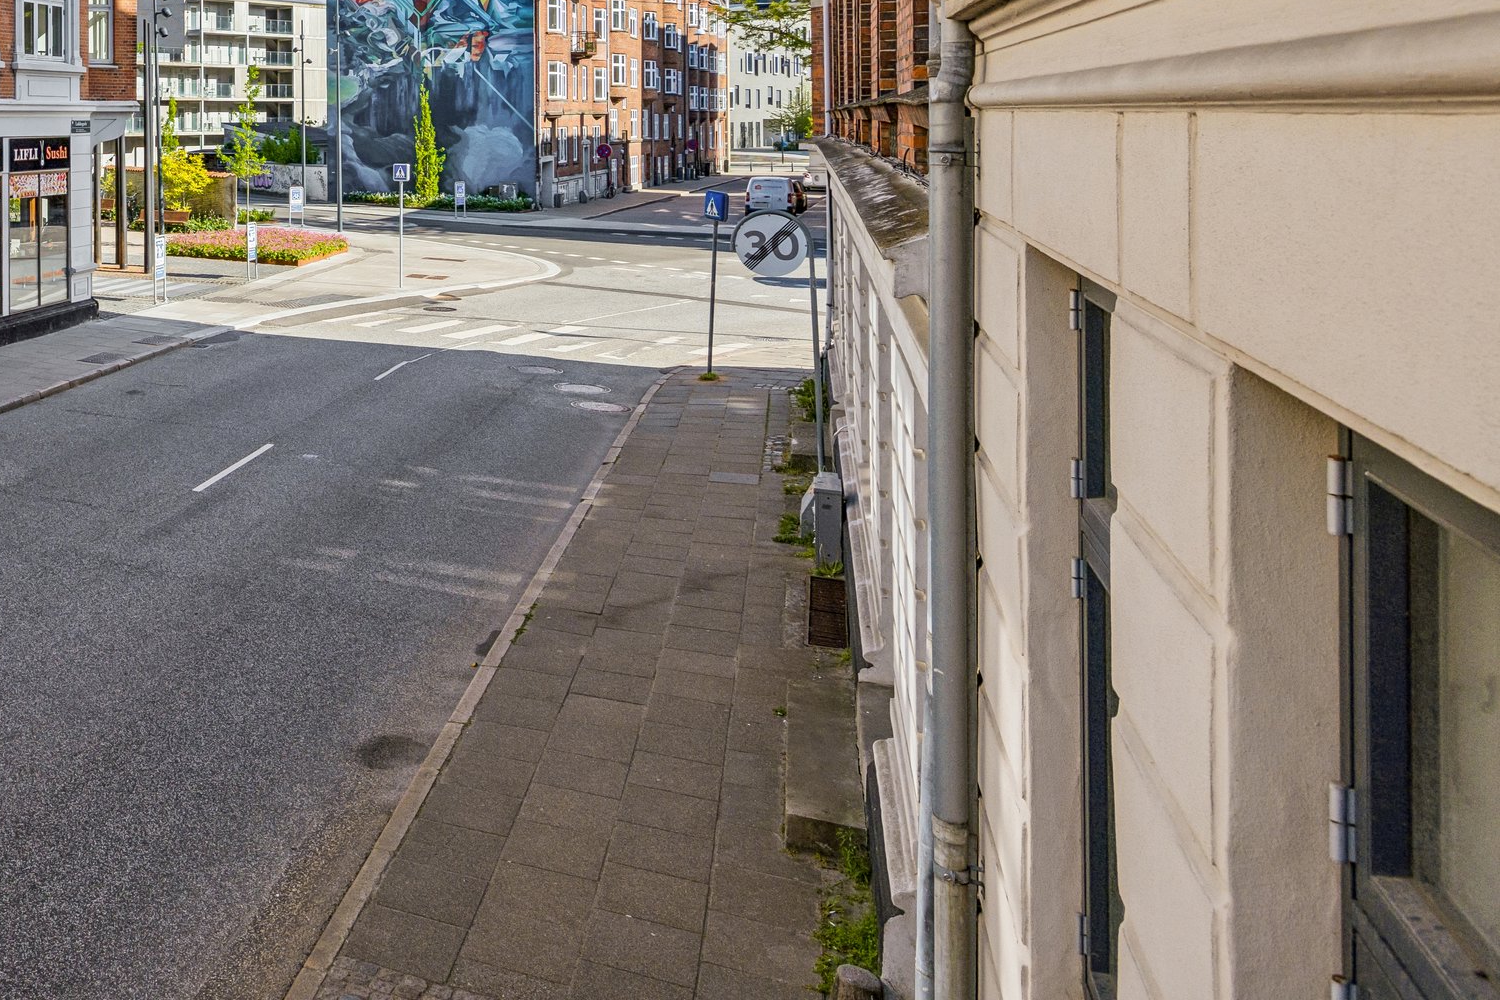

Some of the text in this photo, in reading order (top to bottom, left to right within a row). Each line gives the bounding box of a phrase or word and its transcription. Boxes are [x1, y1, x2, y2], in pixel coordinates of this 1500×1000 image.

[14, 145, 67, 161] LIFLI Sushi
[743, 230, 799, 261] 30
